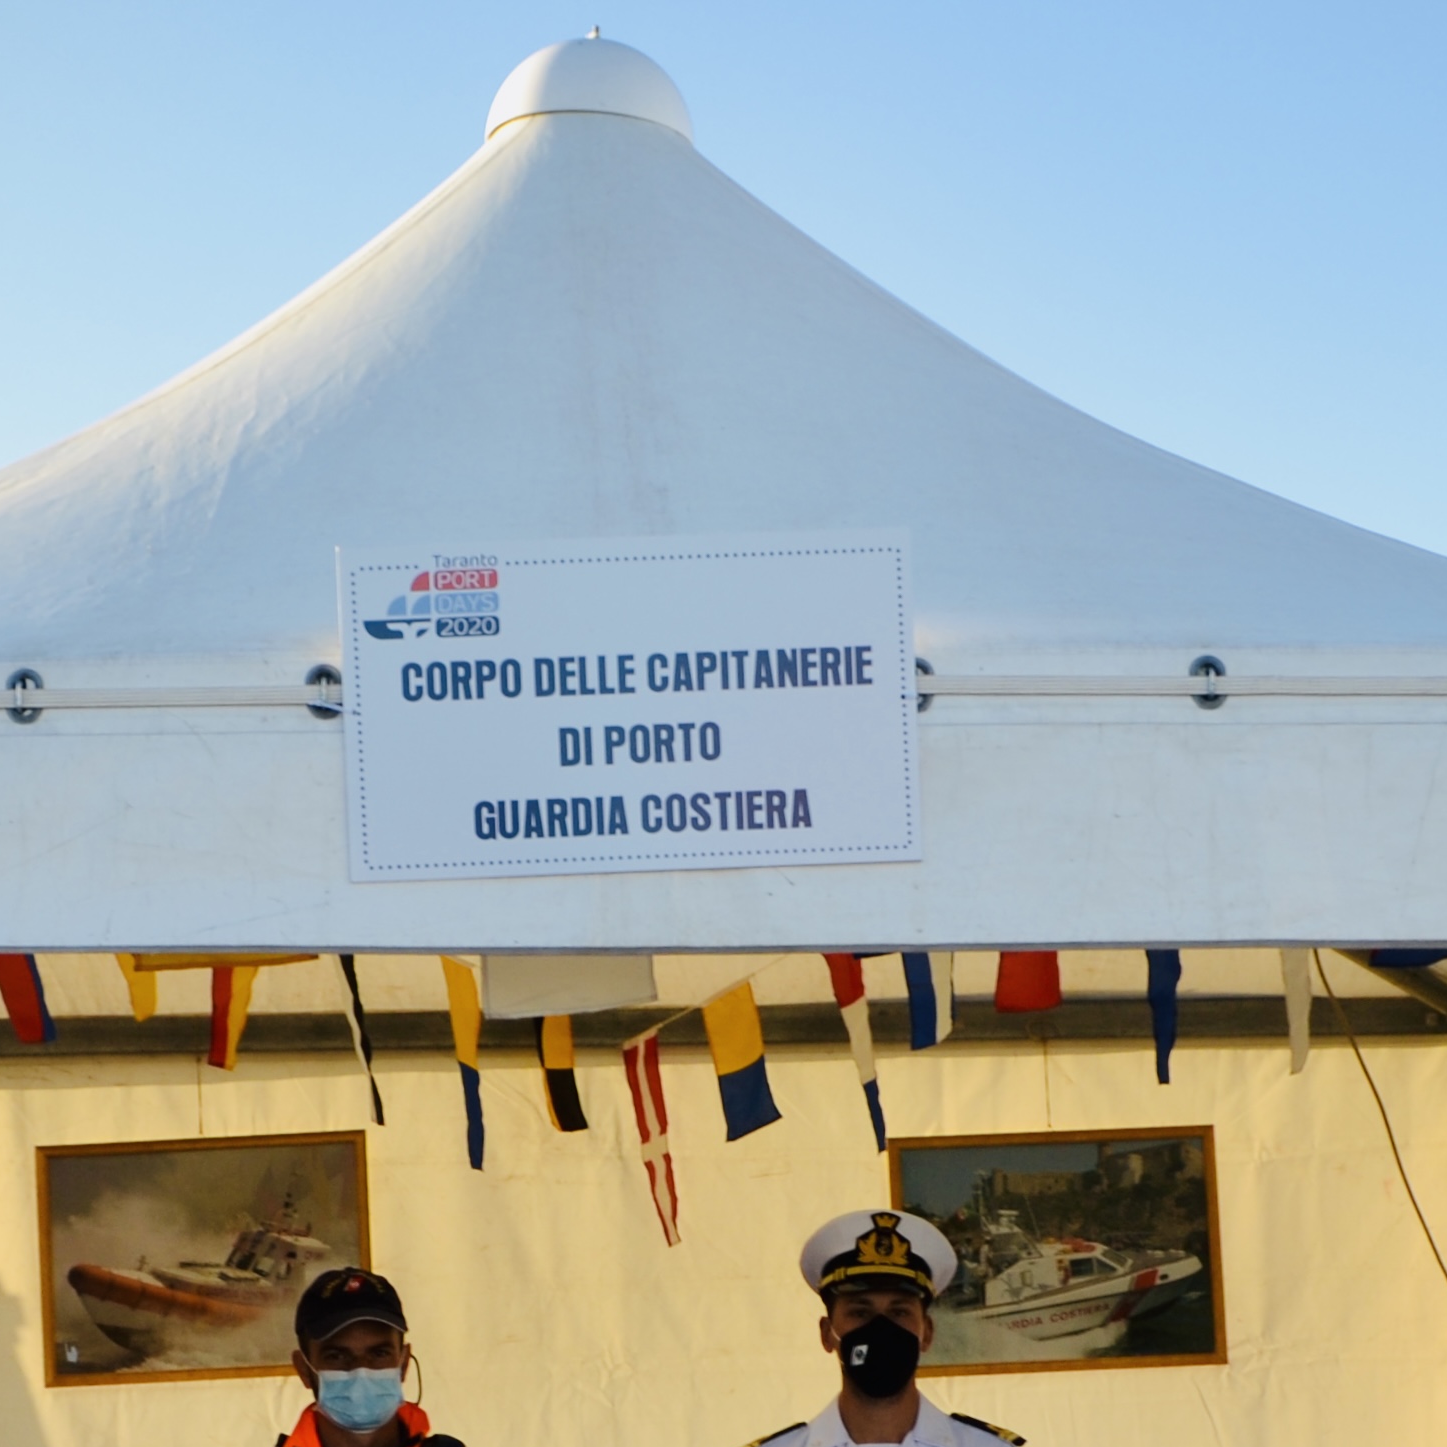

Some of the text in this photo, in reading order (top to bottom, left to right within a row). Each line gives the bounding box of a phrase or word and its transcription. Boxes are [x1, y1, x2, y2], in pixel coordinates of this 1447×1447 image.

[433, 554, 498, 568] Taranto
[436, 570, 494, 590] PORT
[437, 594, 495, 613] DAYS
[439, 616, 497, 637] 2020
[401, 645, 873, 702] CORPO DELLE CAPITANERIE
[558, 721, 721, 766] DI PORTO
[474, 789, 813, 840] GUARDIA COSTIERA
